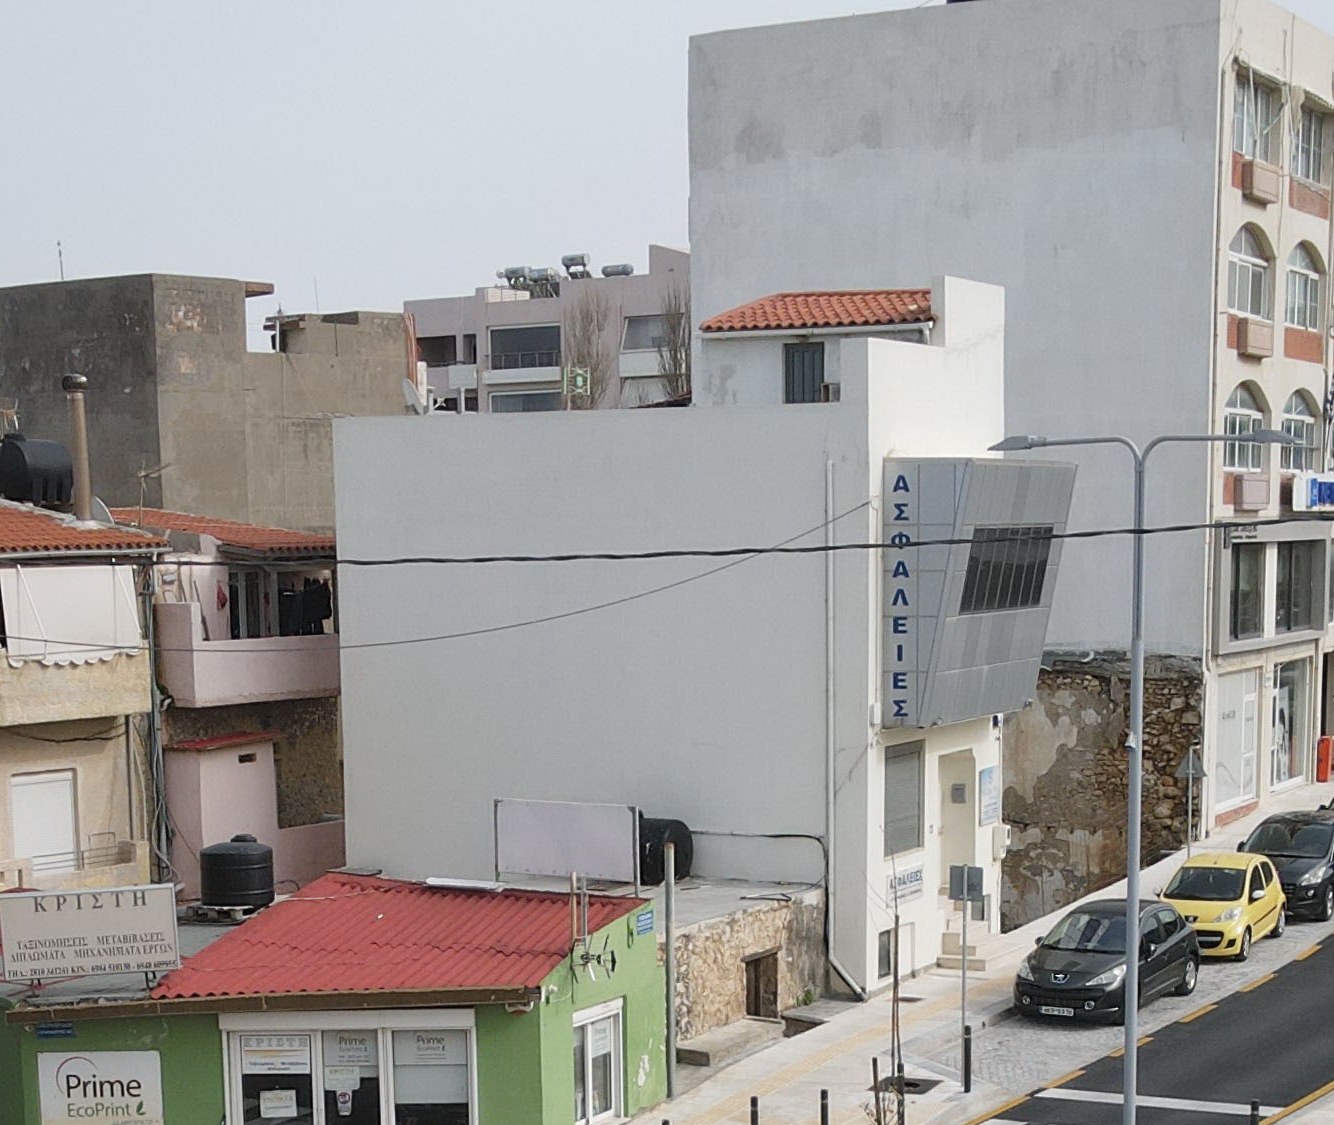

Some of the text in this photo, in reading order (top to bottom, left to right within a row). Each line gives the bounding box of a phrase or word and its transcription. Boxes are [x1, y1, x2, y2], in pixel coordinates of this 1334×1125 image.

[891, 474, 911, 718] ΑΣΦΑΛΕΙΕΣ
[34, 890, 147, 912] ΚΡΙΣΤΗ
[417, 1035, 445, 1045] Prime
[66, 1074, 142, 1098] Prime
[67, 1102, 132, 1118] EcoPrint
